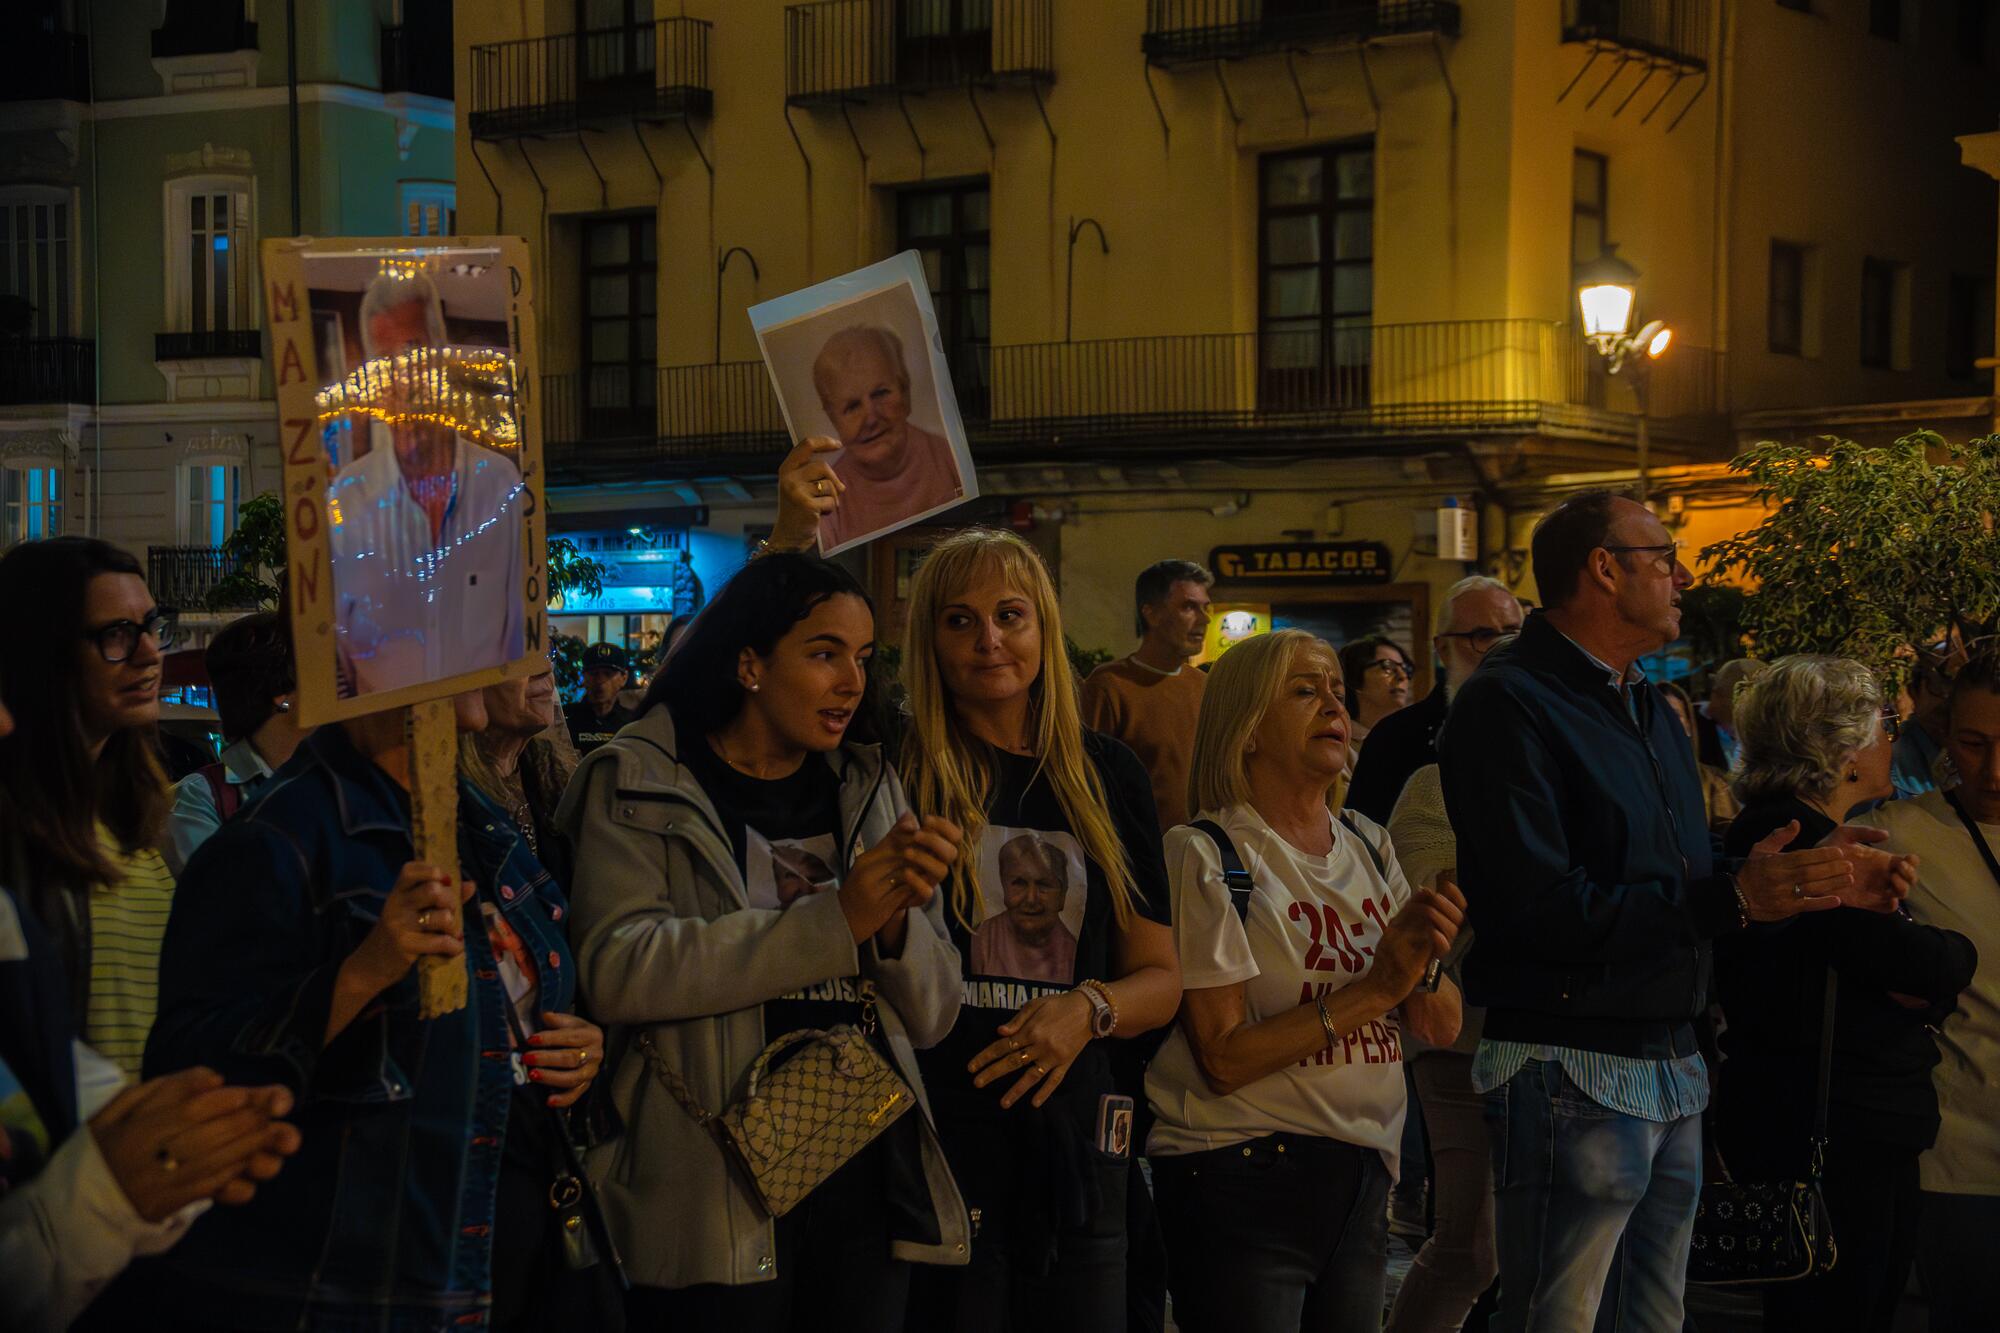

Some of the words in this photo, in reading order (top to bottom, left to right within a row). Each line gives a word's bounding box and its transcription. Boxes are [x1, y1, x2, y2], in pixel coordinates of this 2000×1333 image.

[271, 279, 319, 615] MAZÓN
[1255, 550, 1377, 570] TABACOS
[962, 980, 1029, 1009] MARIA
